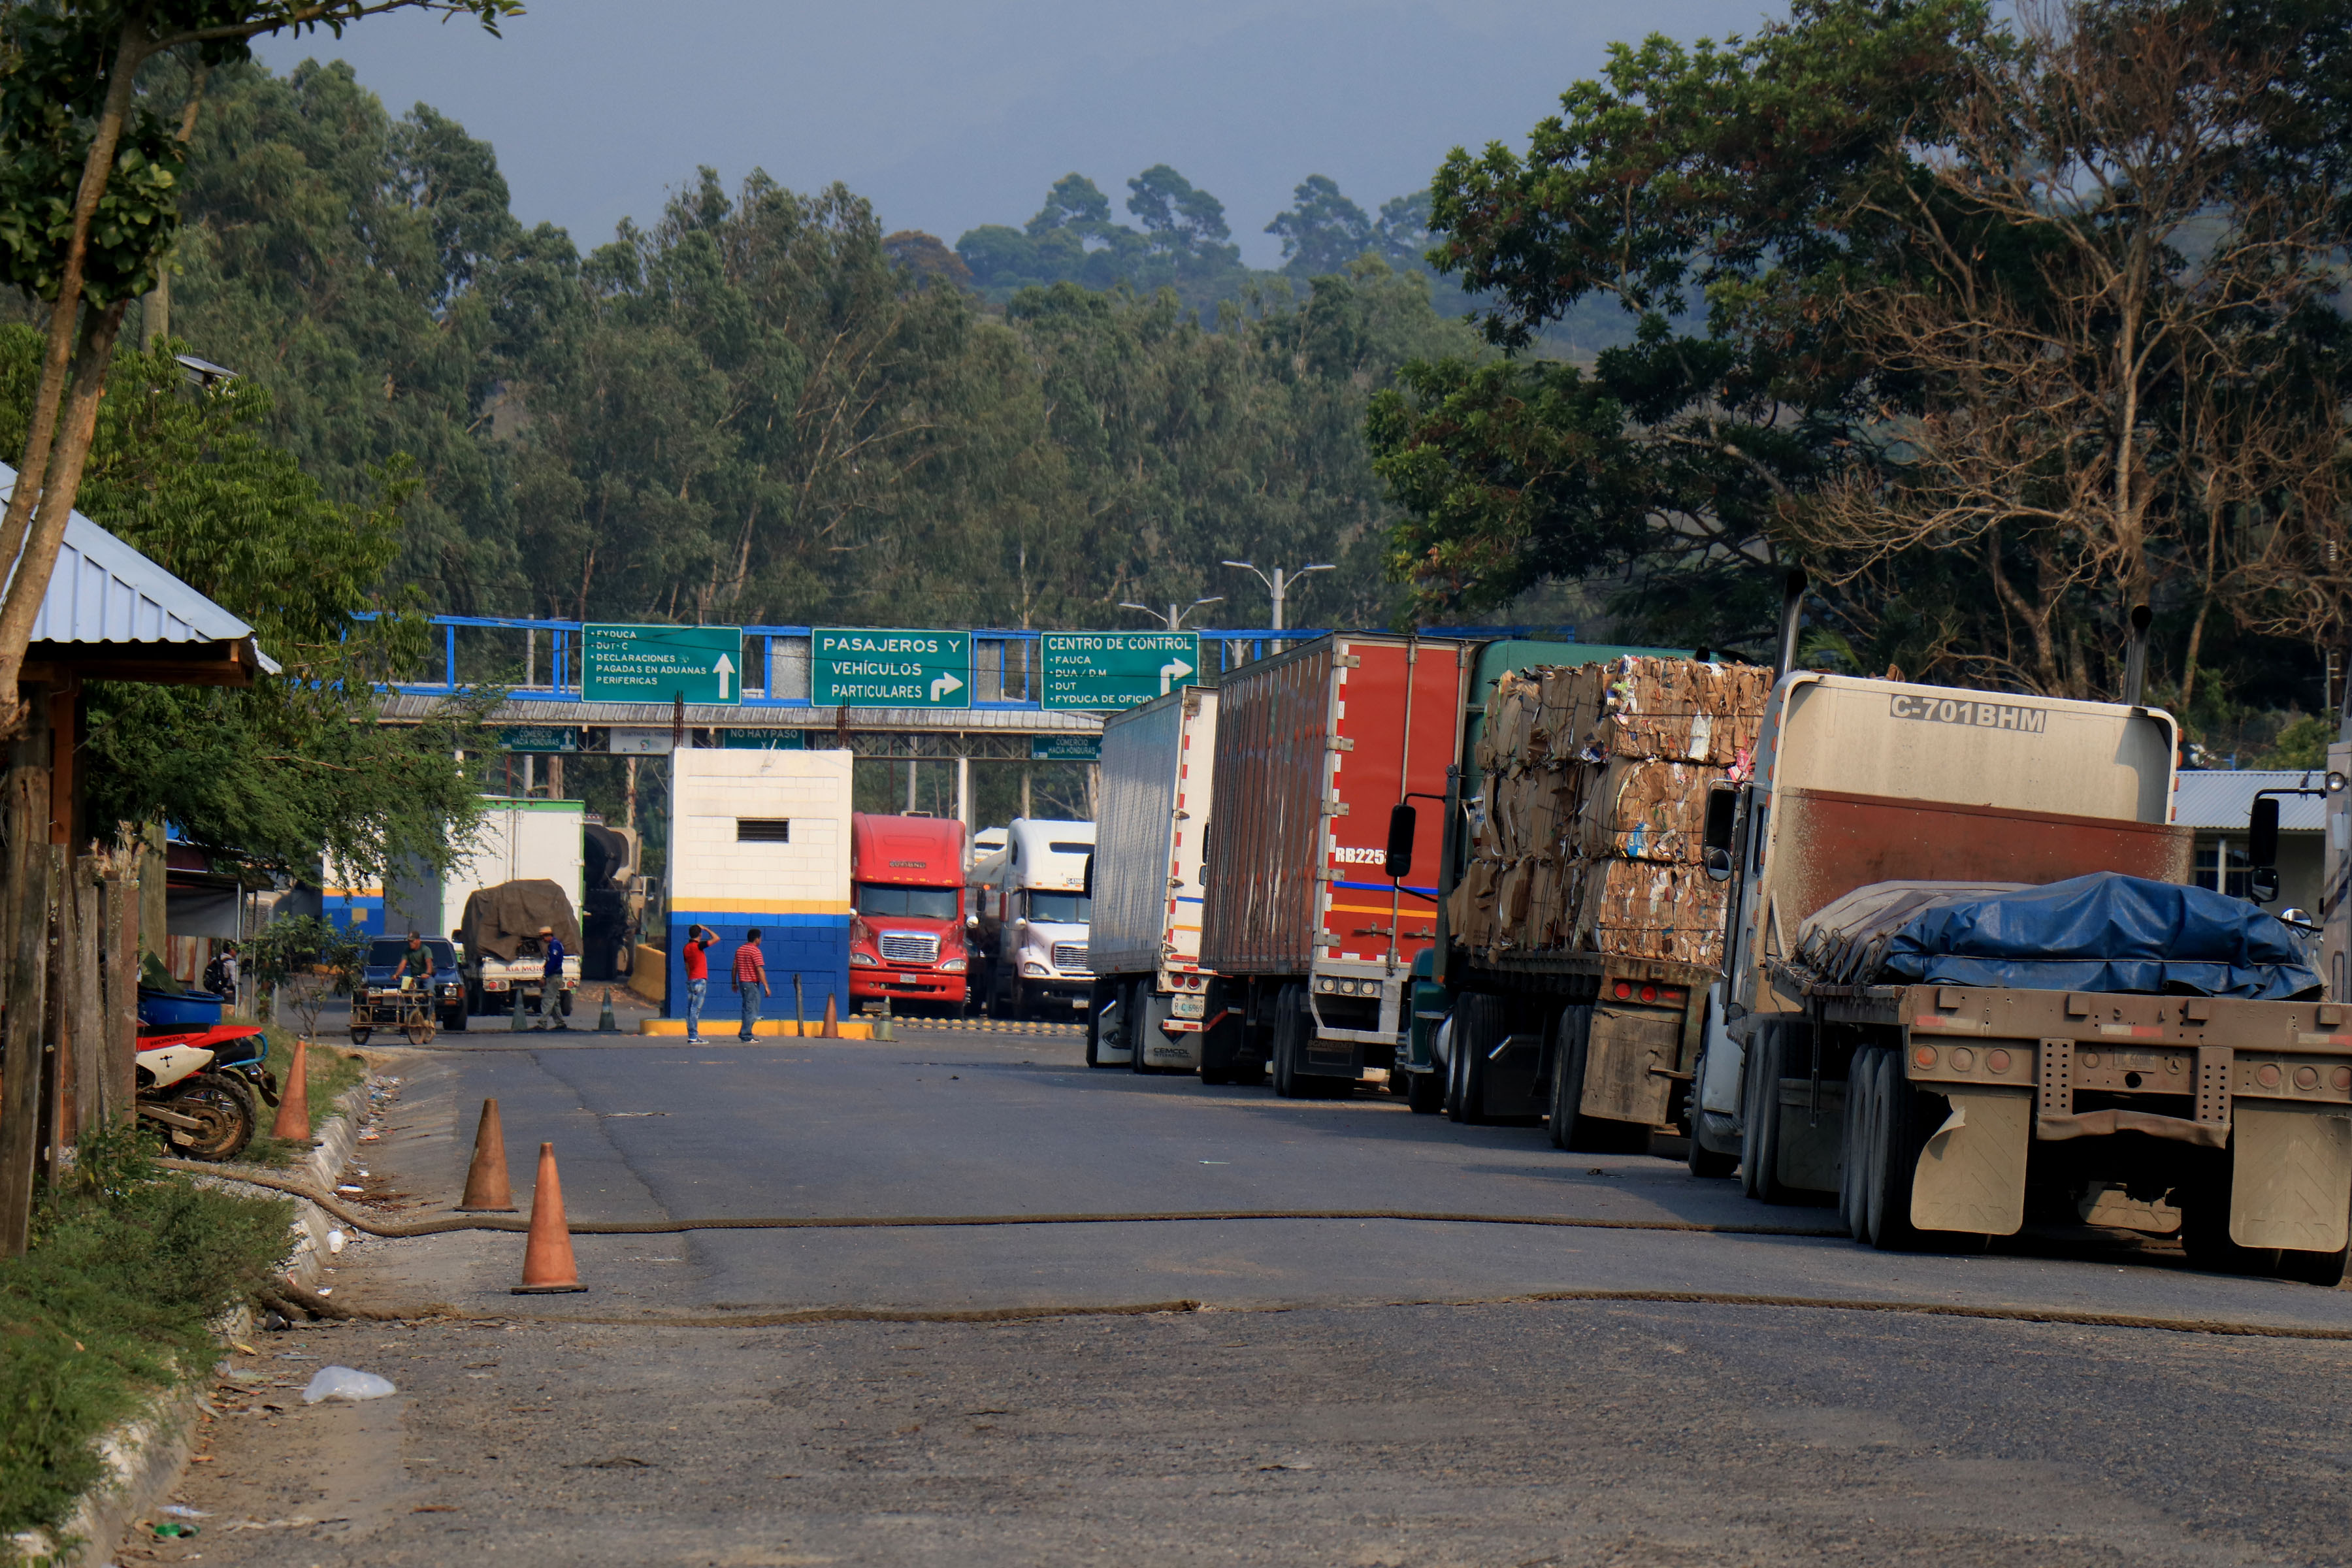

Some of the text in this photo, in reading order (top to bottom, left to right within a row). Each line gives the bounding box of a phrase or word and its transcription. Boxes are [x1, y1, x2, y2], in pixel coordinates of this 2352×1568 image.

[823, 638, 960, 653] PASAJEROS Y
[1049, 638, 1192, 650] CENTRO DE CONTROL
[596, 654, 676, 662] DECLARACIONES
[596, 665, 642, 674] PAGADAS
[832, 660, 923, 676] VEHÍCULOS
[831, 685, 923, 698] PARTICULARES
[1118, 695, 1154, 704] OFICIO
[1891, 695, 2045, 732] C-701BHM
[770, 730, 798, 738] PASO
[1335, 847, 1387, 865] RB225
[150, 1035, 188, 1046] HONDA
